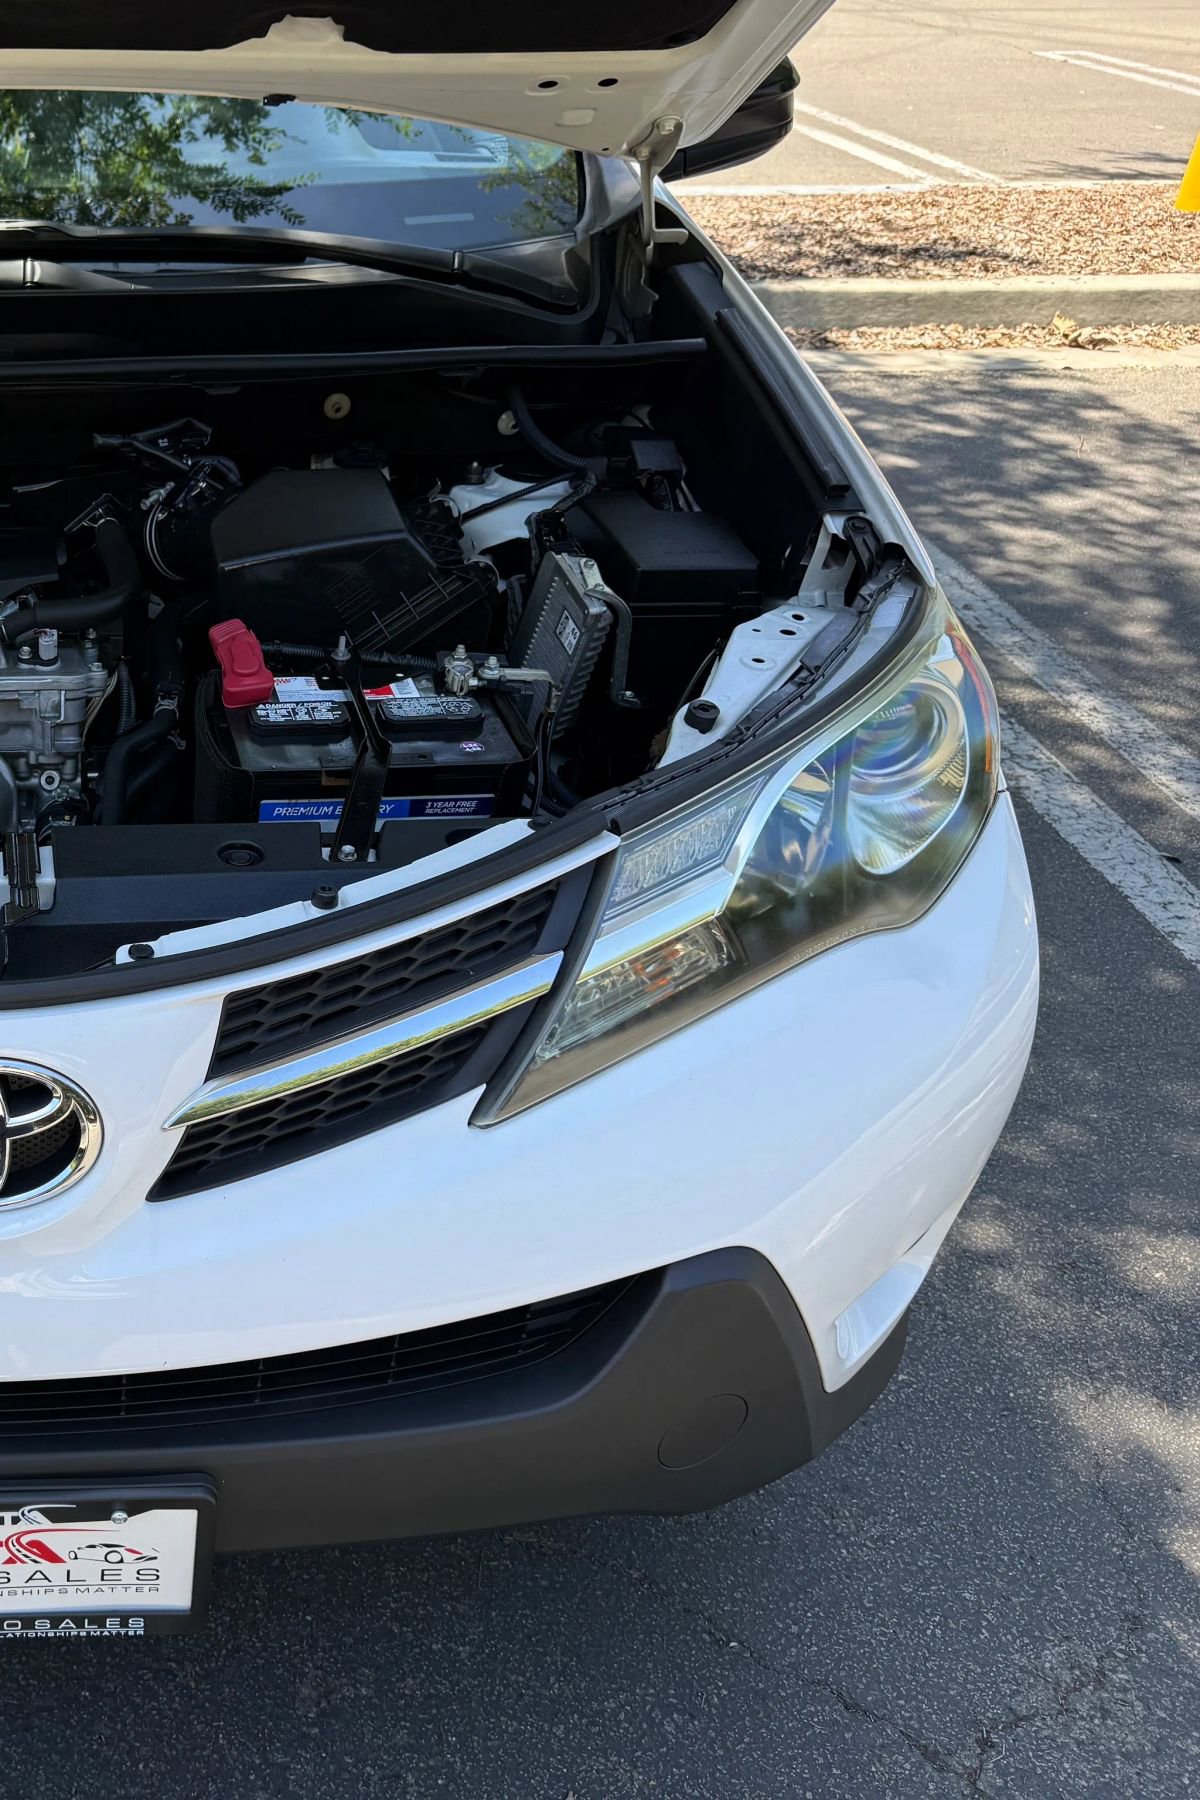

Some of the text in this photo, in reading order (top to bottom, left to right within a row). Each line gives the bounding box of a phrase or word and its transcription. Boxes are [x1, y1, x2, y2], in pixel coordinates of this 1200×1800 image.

[425, 801, 432, 809] 3
[456, 800, 479, 808] FREE
[273, 805, 334, 817] PREMIUM
[75, 1586, 160, 1595] MATTER
[34, 1617, 145, 1630] SALES
